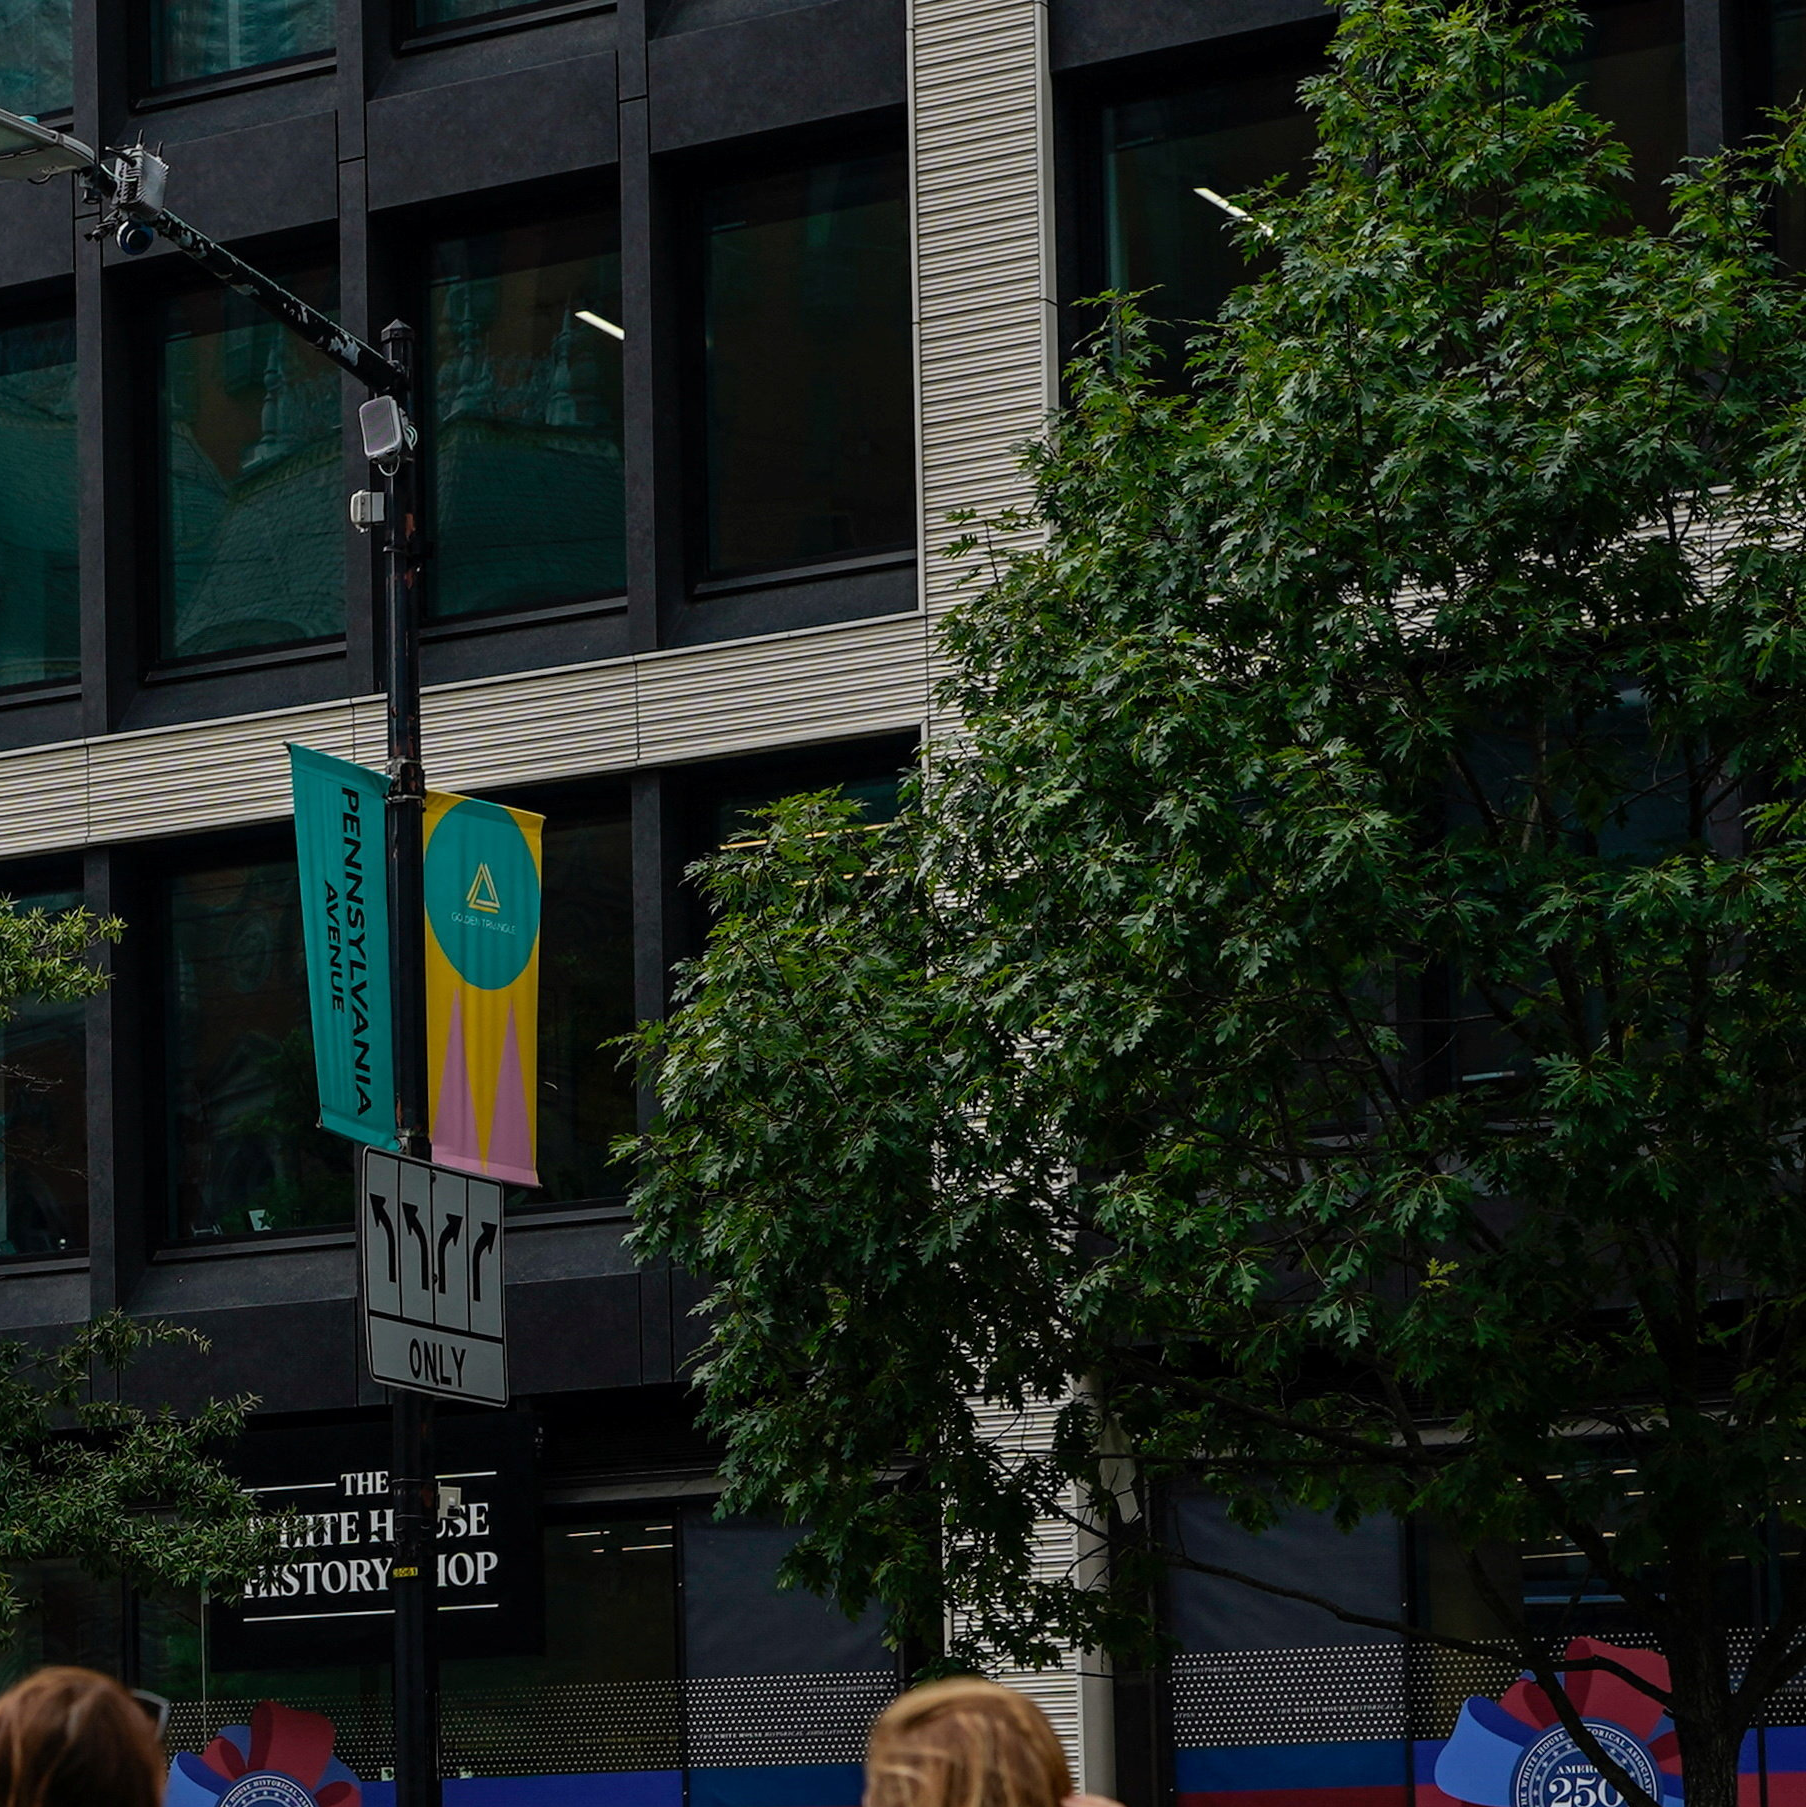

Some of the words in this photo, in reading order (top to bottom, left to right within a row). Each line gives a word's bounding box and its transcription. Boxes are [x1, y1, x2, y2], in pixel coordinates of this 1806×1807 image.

[323, 879, 346, 1014] AVENUE
[341, 787, 373, 1117] PENNSYLVANIA
[409, 1337, 467, 1389] ONLY
[341, 1470, 389, 1496] THE
[247, 1511, 360, 1549] HITE
[369, 1502, 490, 1543] HSE
[437, 1551, 499, 1587] OP
[1521, 1755, 1539, 1788] WHITE
[1537, 1732, 1566, 1755] HOUSE
[1585, 1727, 1626, 1746] ORICAL
[229, 1785, 251, 1803] HOUSE
[253, 1780, 298, 1796] HISTORICAL
